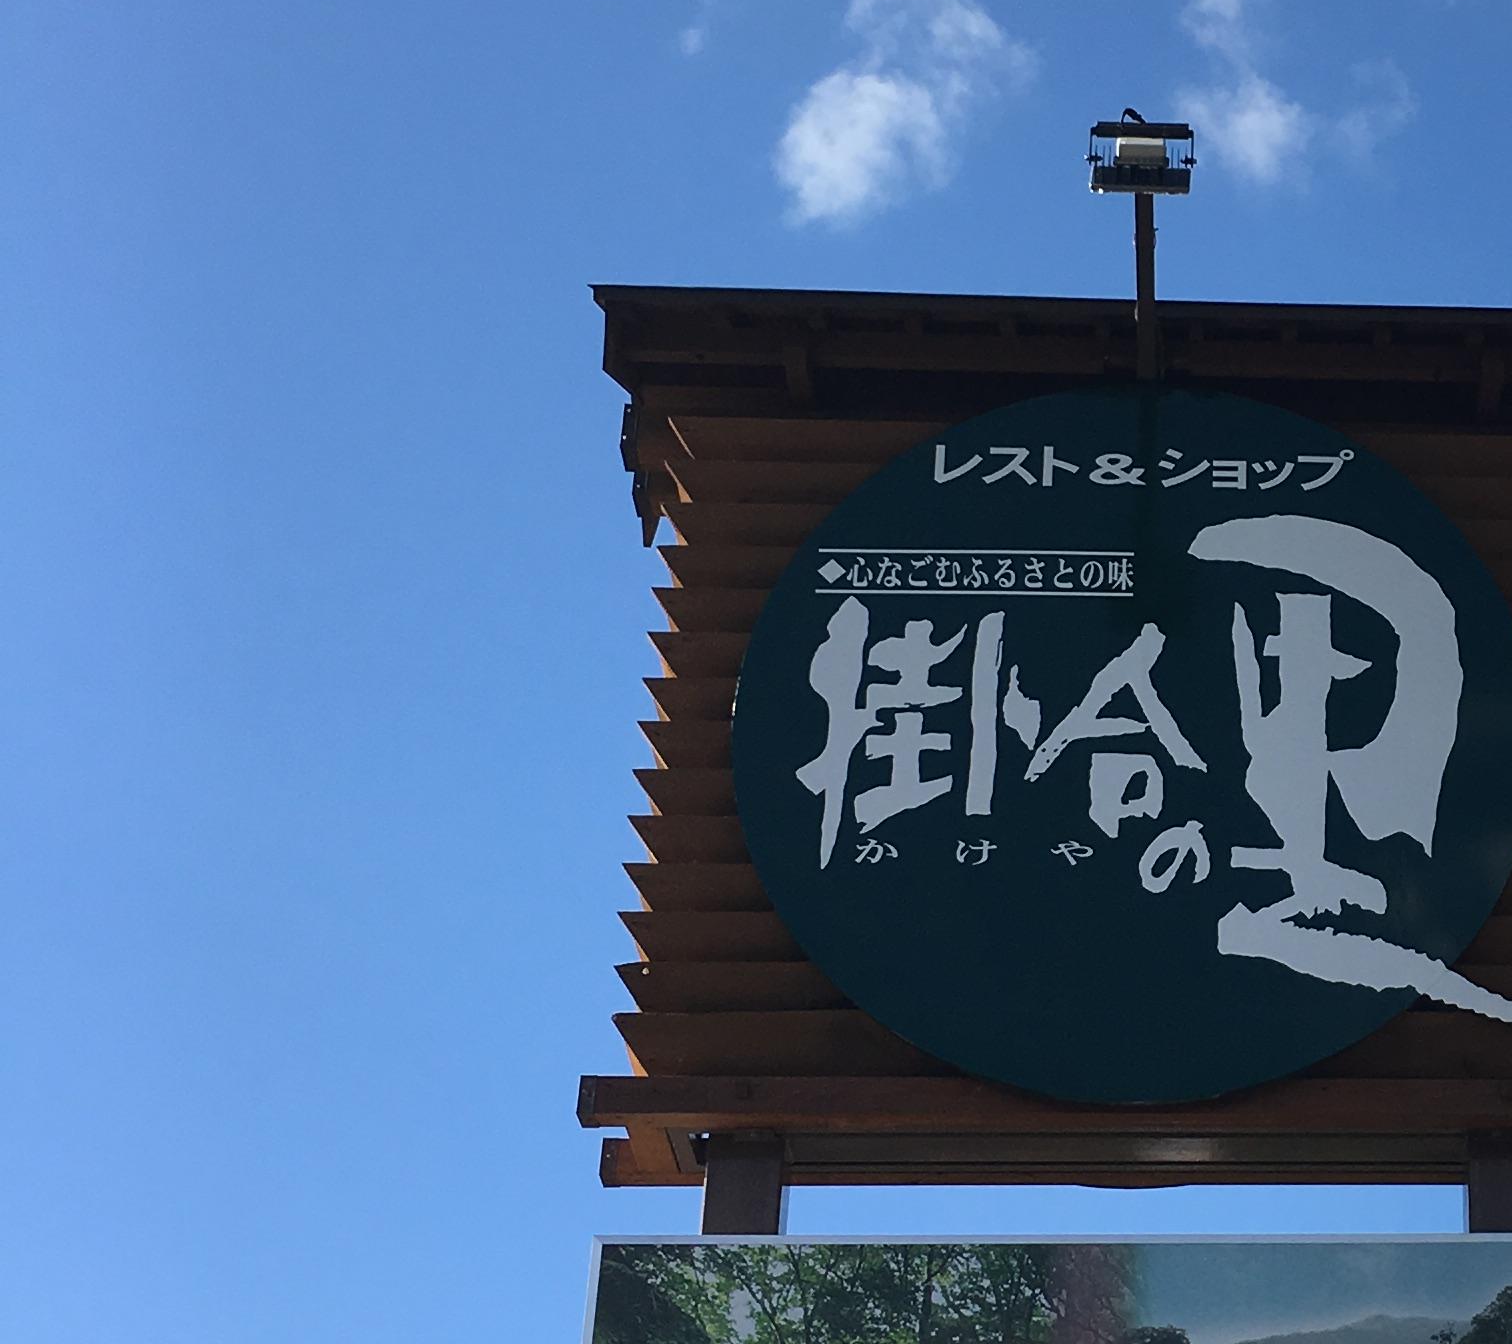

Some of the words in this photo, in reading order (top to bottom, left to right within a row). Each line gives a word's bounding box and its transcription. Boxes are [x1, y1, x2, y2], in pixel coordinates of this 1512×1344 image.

[933, 443, 1355, 492] レスト&ショップ
[854, 838, 1095, 866] かけや
